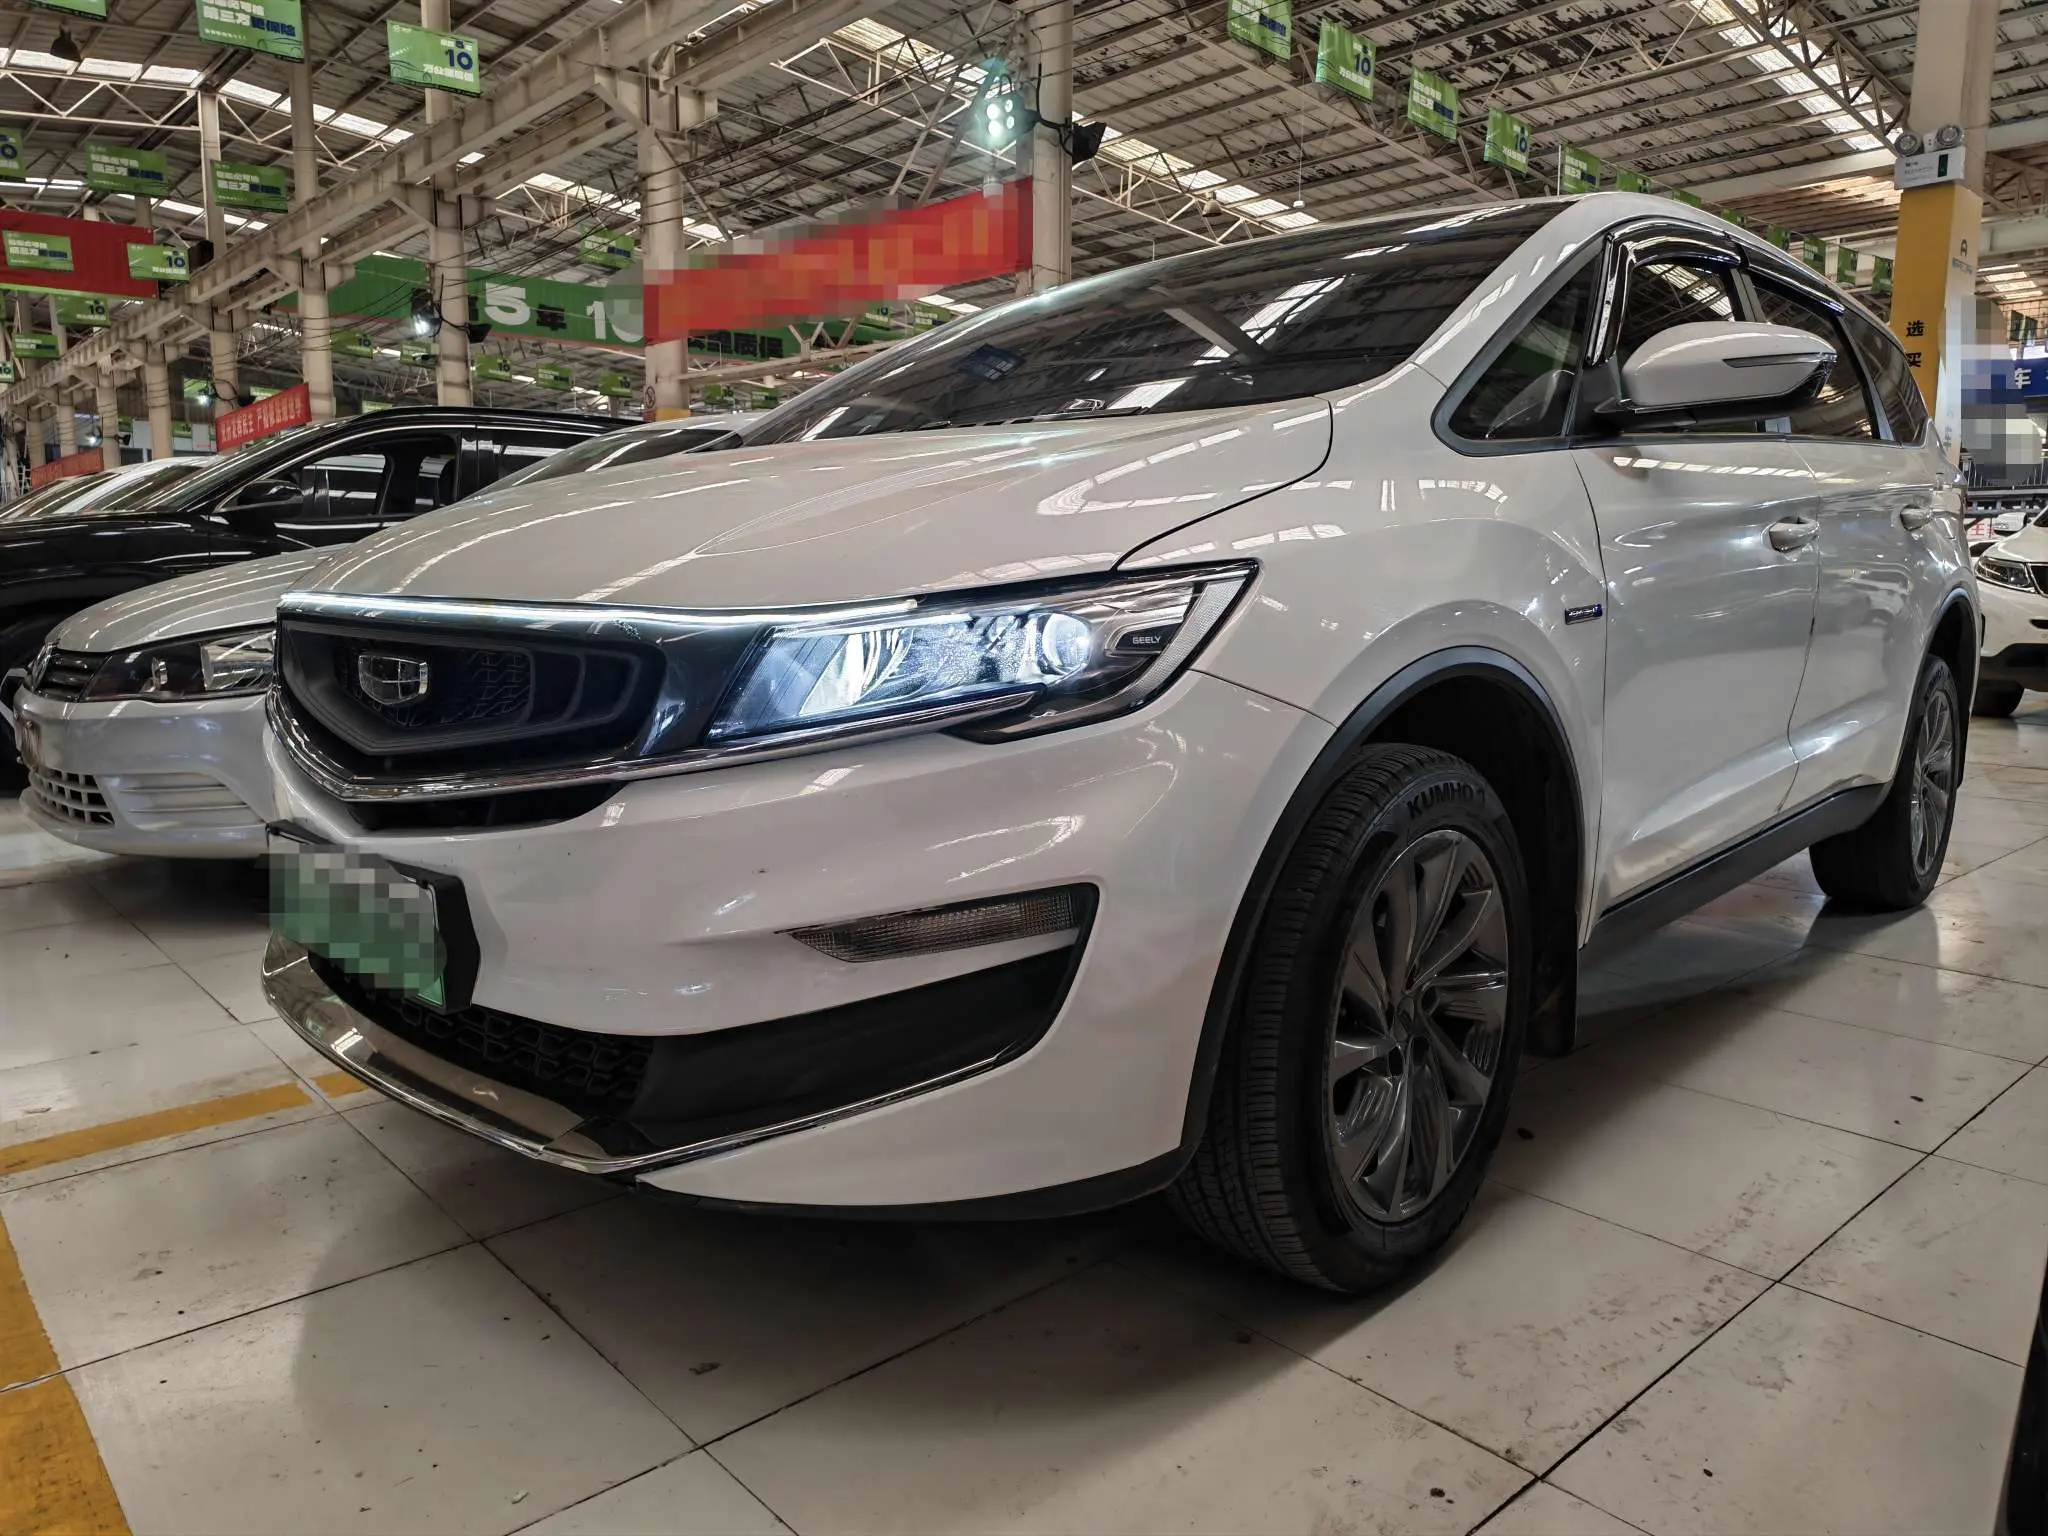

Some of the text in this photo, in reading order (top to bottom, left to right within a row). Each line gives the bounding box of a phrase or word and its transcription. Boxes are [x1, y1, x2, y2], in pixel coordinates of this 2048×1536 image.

[445, 48, 473, 70] 10
[1354, 56, 1371, 76] 10
[1514, 132, 1527, 153] 10
[167, 256, 185, 268] 10
[89, 305, 105, 314] 10
[1132, 635, 1161, 645] GEELY
[1407, 782, 1474, 820] KUMHO
